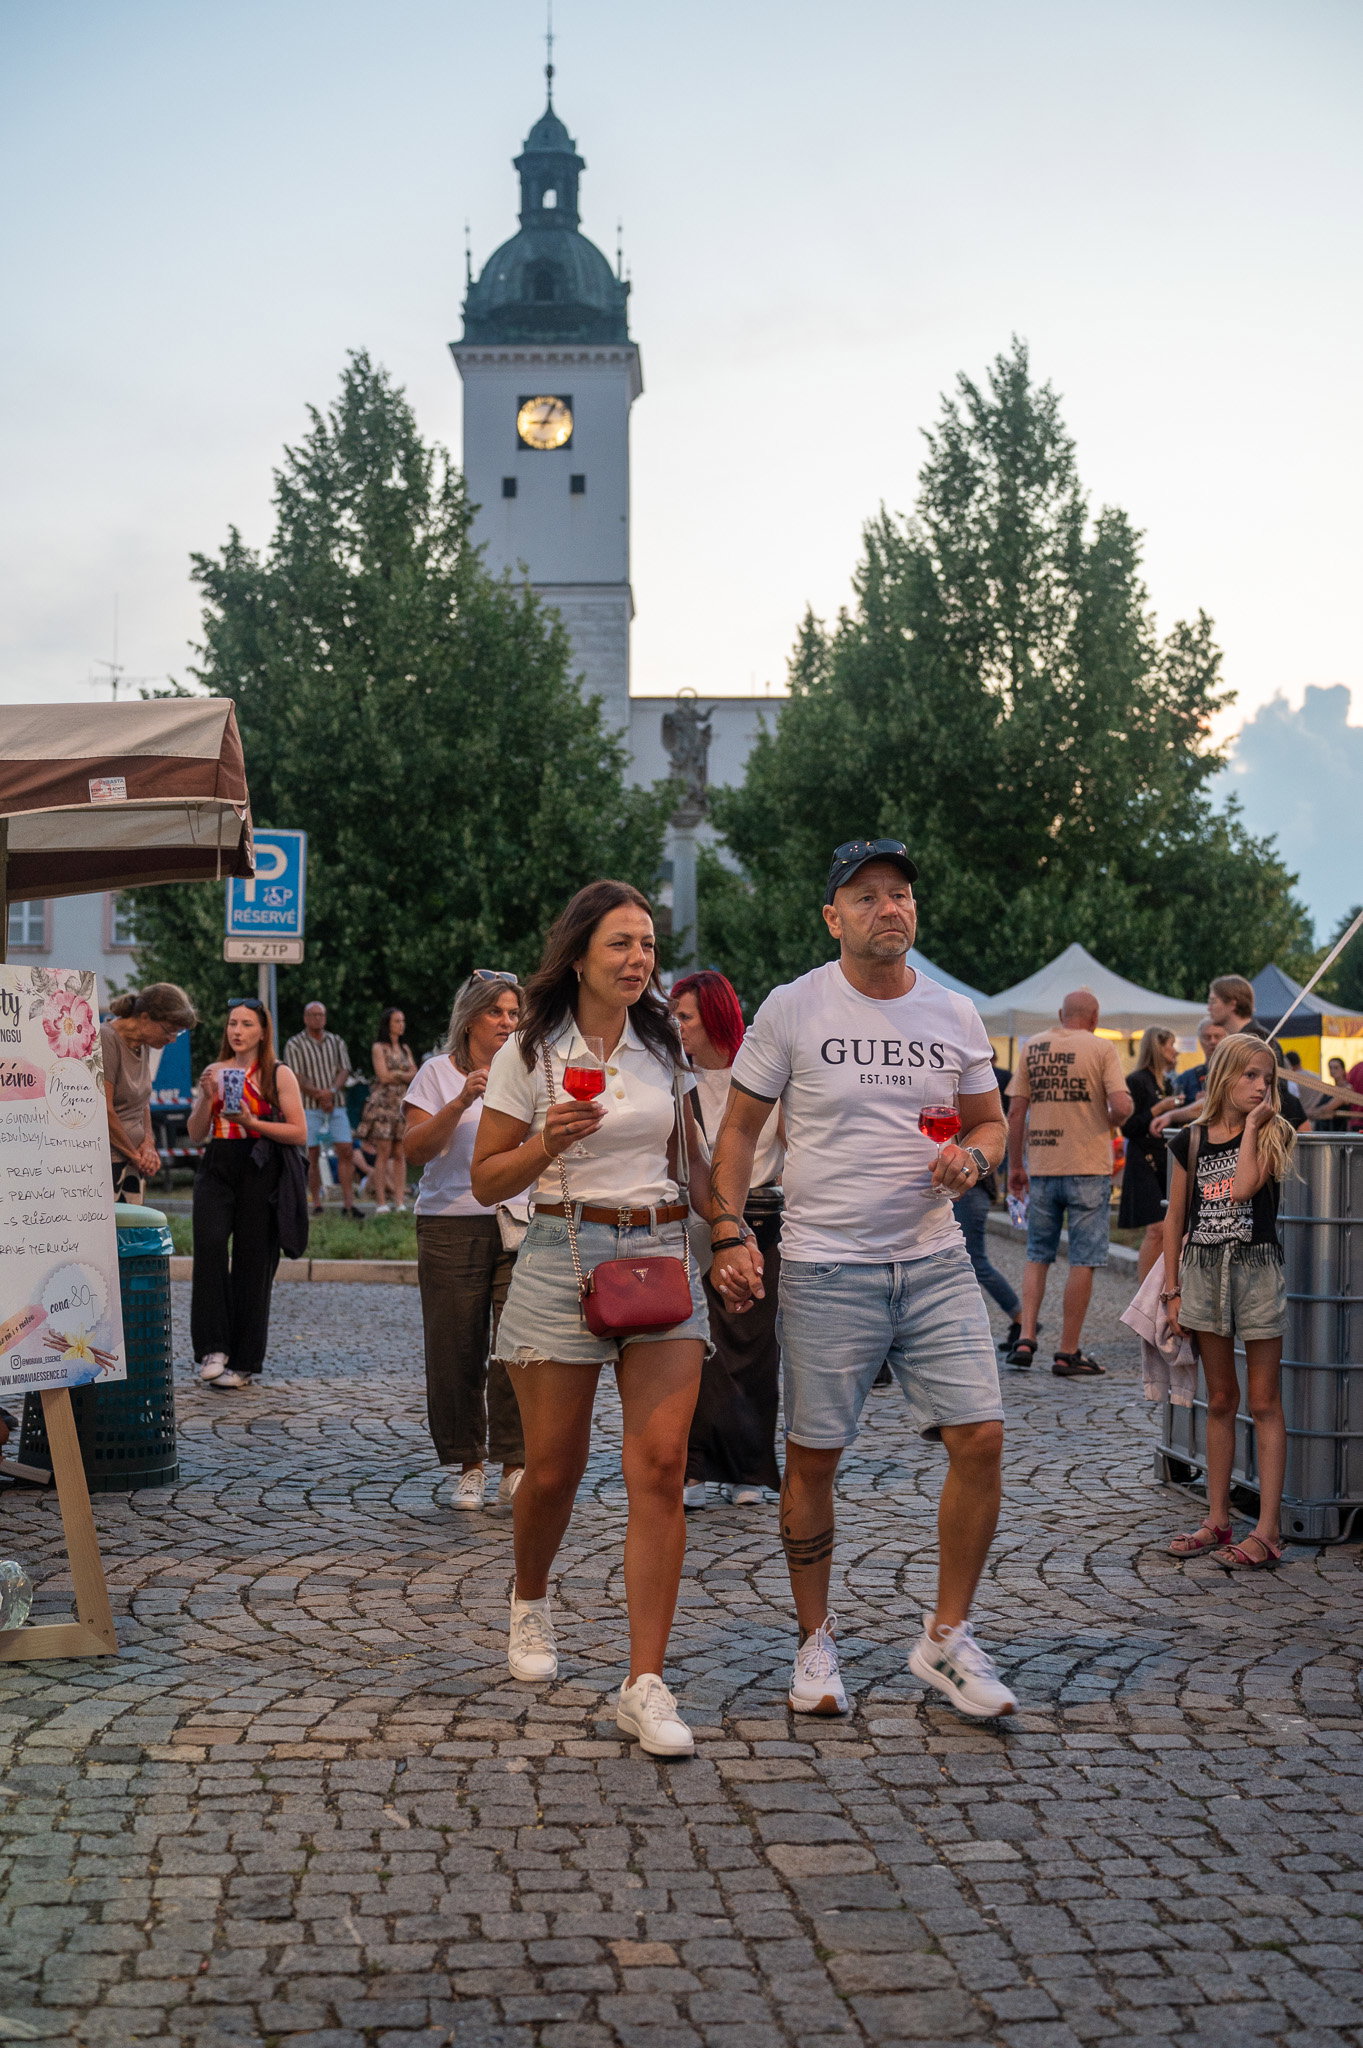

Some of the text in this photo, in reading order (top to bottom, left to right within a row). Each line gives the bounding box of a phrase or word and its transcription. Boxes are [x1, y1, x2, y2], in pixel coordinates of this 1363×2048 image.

[245, 844, 288, 902] P
[234, 908, 296, 924] RÉSERVÉ
[242, 944, 288, 956] 2x ZTP
[0, 988, 22, 1027] ty
[821, 1038, 945, 1069] GUESS
[1028, 1041, 1051, 1054] THE
[1027, 1053, 1076, 1066] FUTURE
[49, 1076, 91, 1094] Moravia
[60, 1092, 96, 1107] Essence
[46, 1164, 93, 1175] VANILKY
